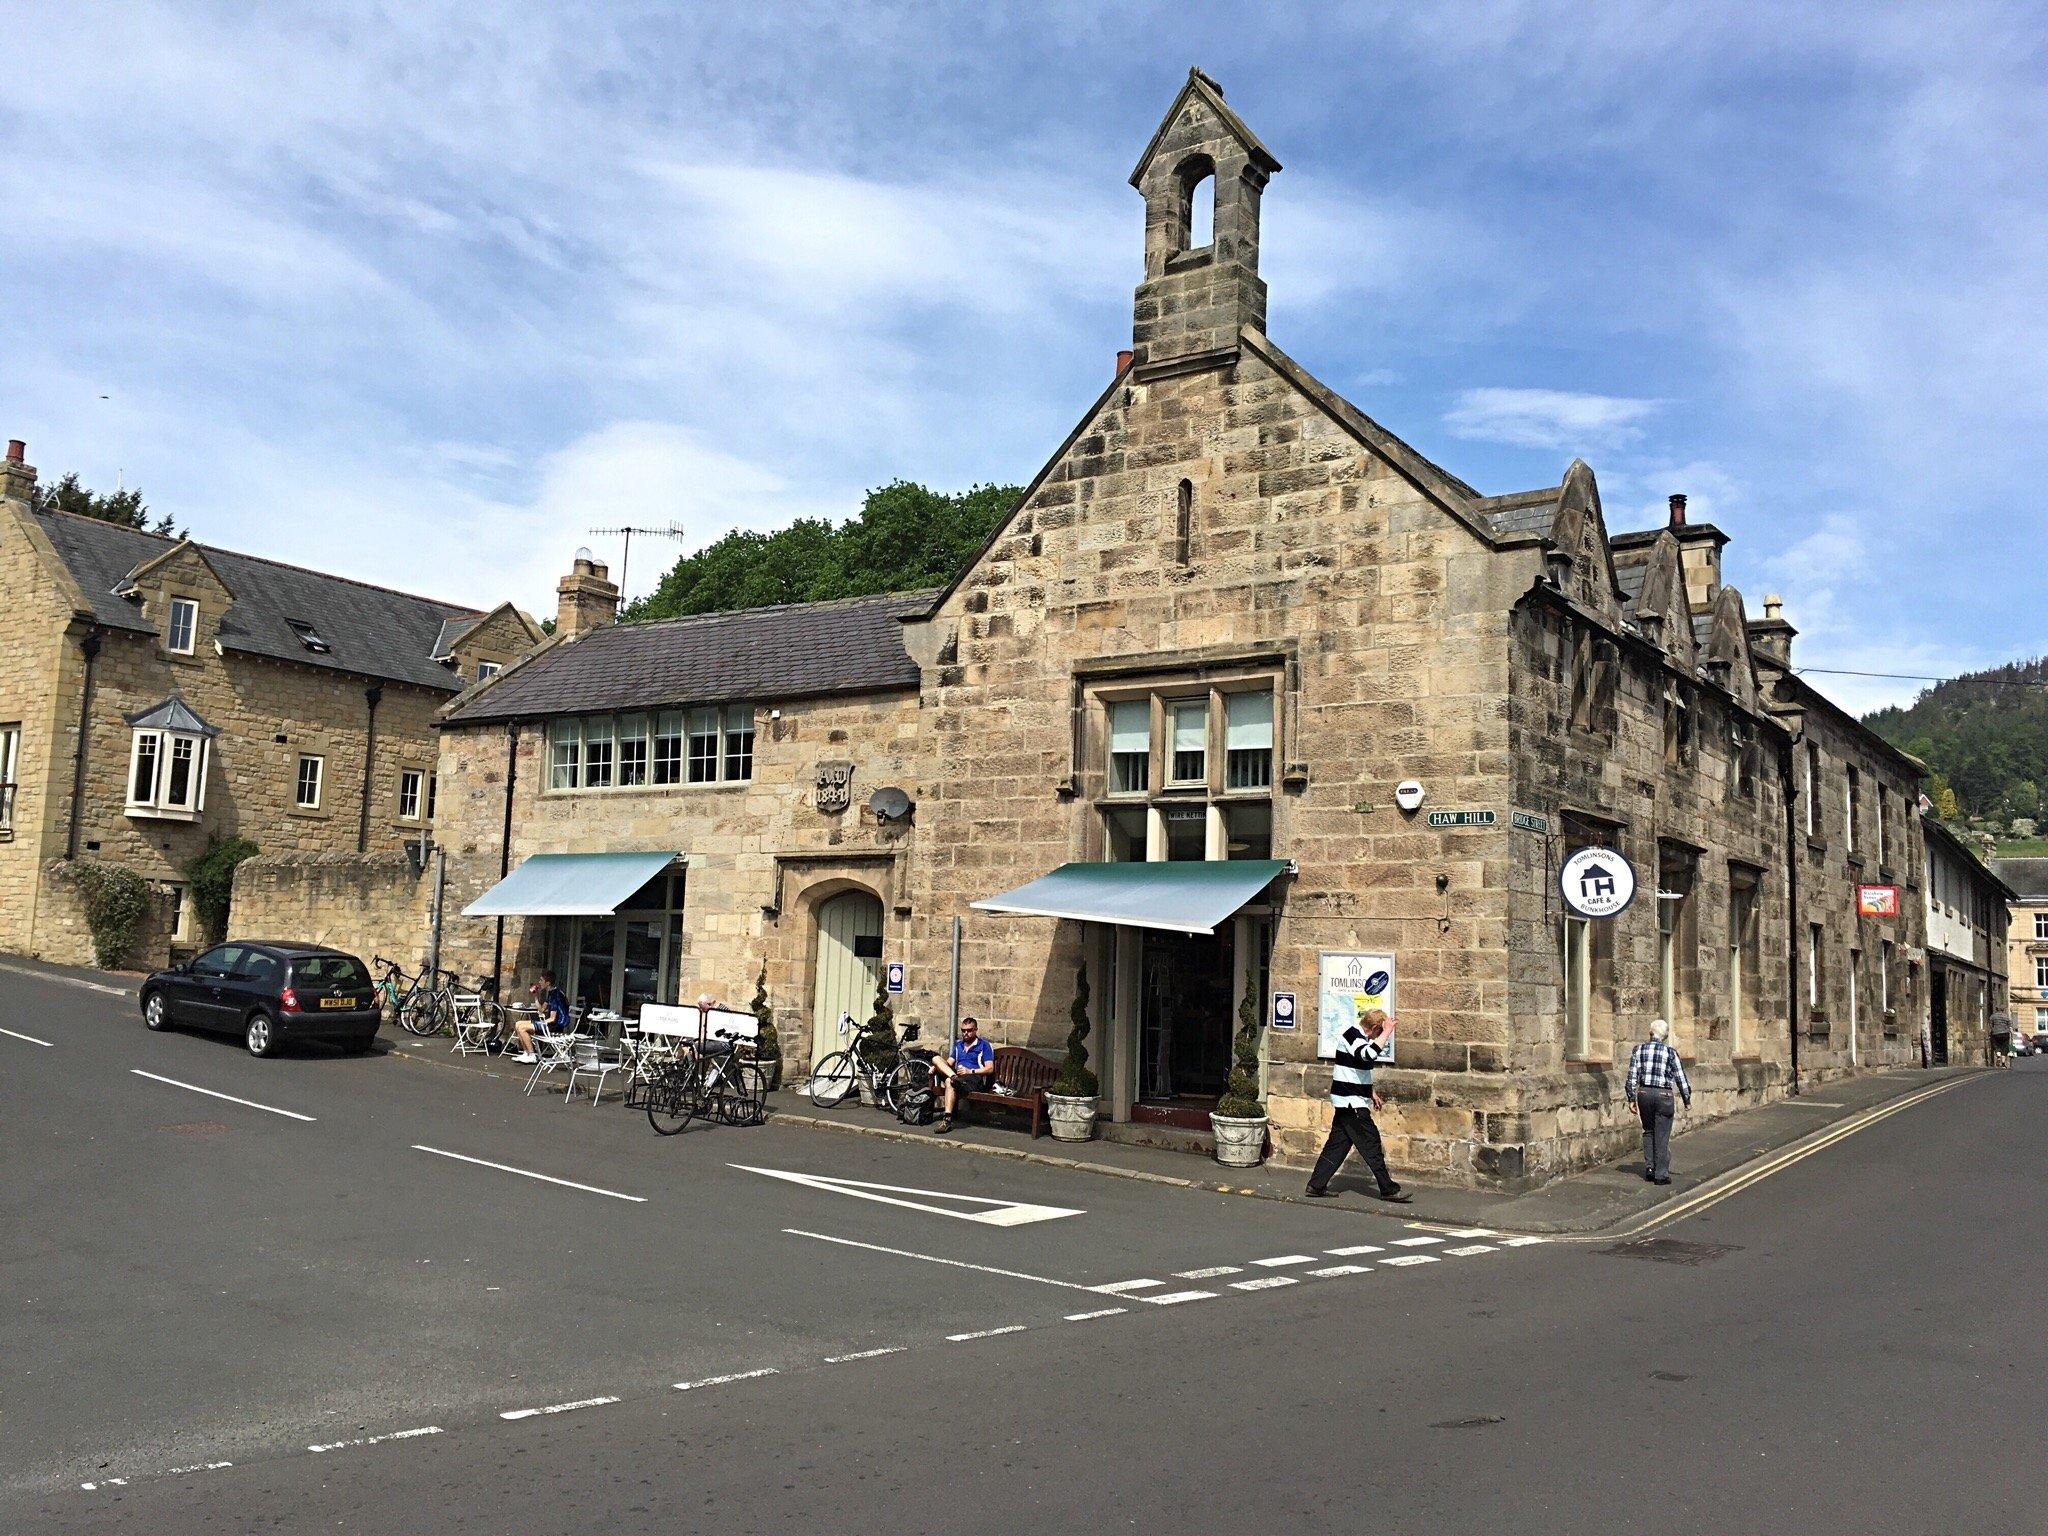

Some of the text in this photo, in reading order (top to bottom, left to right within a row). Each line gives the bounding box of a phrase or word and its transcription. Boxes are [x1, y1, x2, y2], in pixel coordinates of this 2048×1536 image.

[1433, 812, 1489, 824] HAW HILL
[1514, 812, 1545, 830] BRIDGE STREET
[1573, 852, 1615, 866] TOMLINSONS
[1580, 901, 1620, 913] BUNKHOUSE
